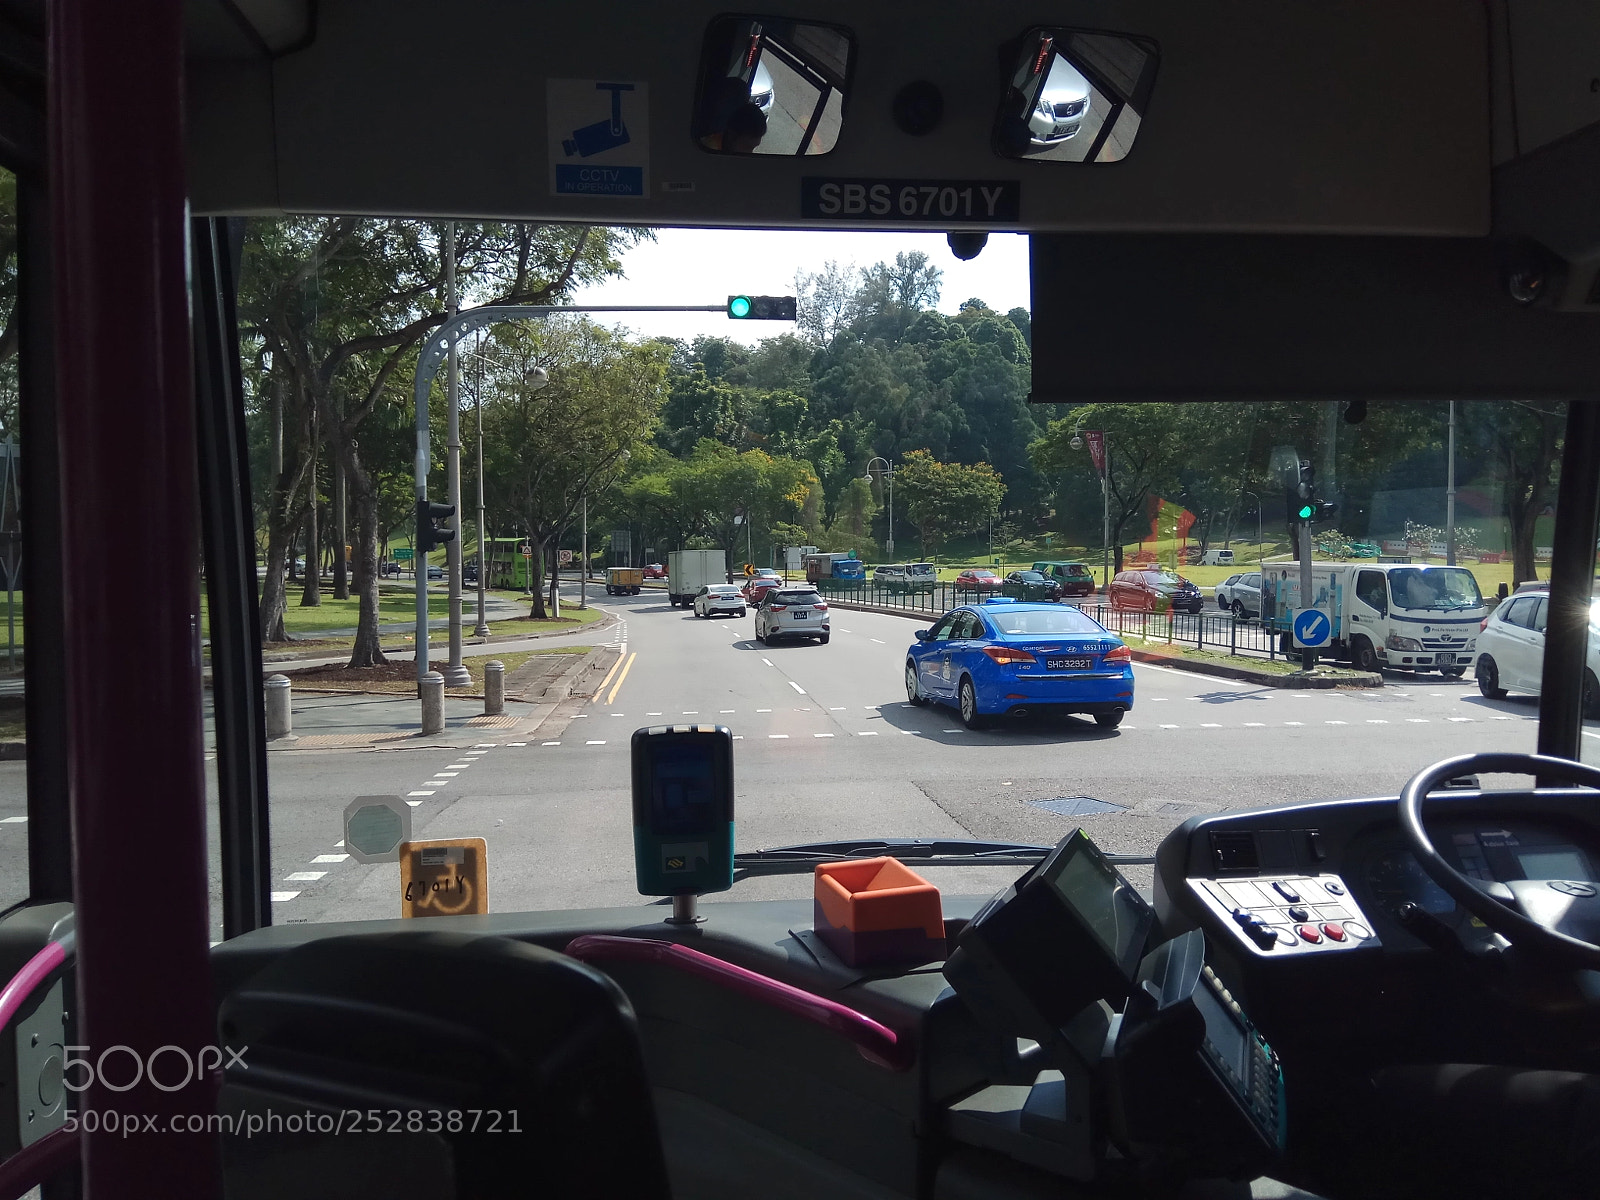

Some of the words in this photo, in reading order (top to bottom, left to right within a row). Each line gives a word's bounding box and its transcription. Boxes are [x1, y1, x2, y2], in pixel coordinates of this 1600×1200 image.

[580, 169, 619, 182] CCTV
[564, 182, 575, 191] IN
[577, 182, 632, 192] OPERATION
